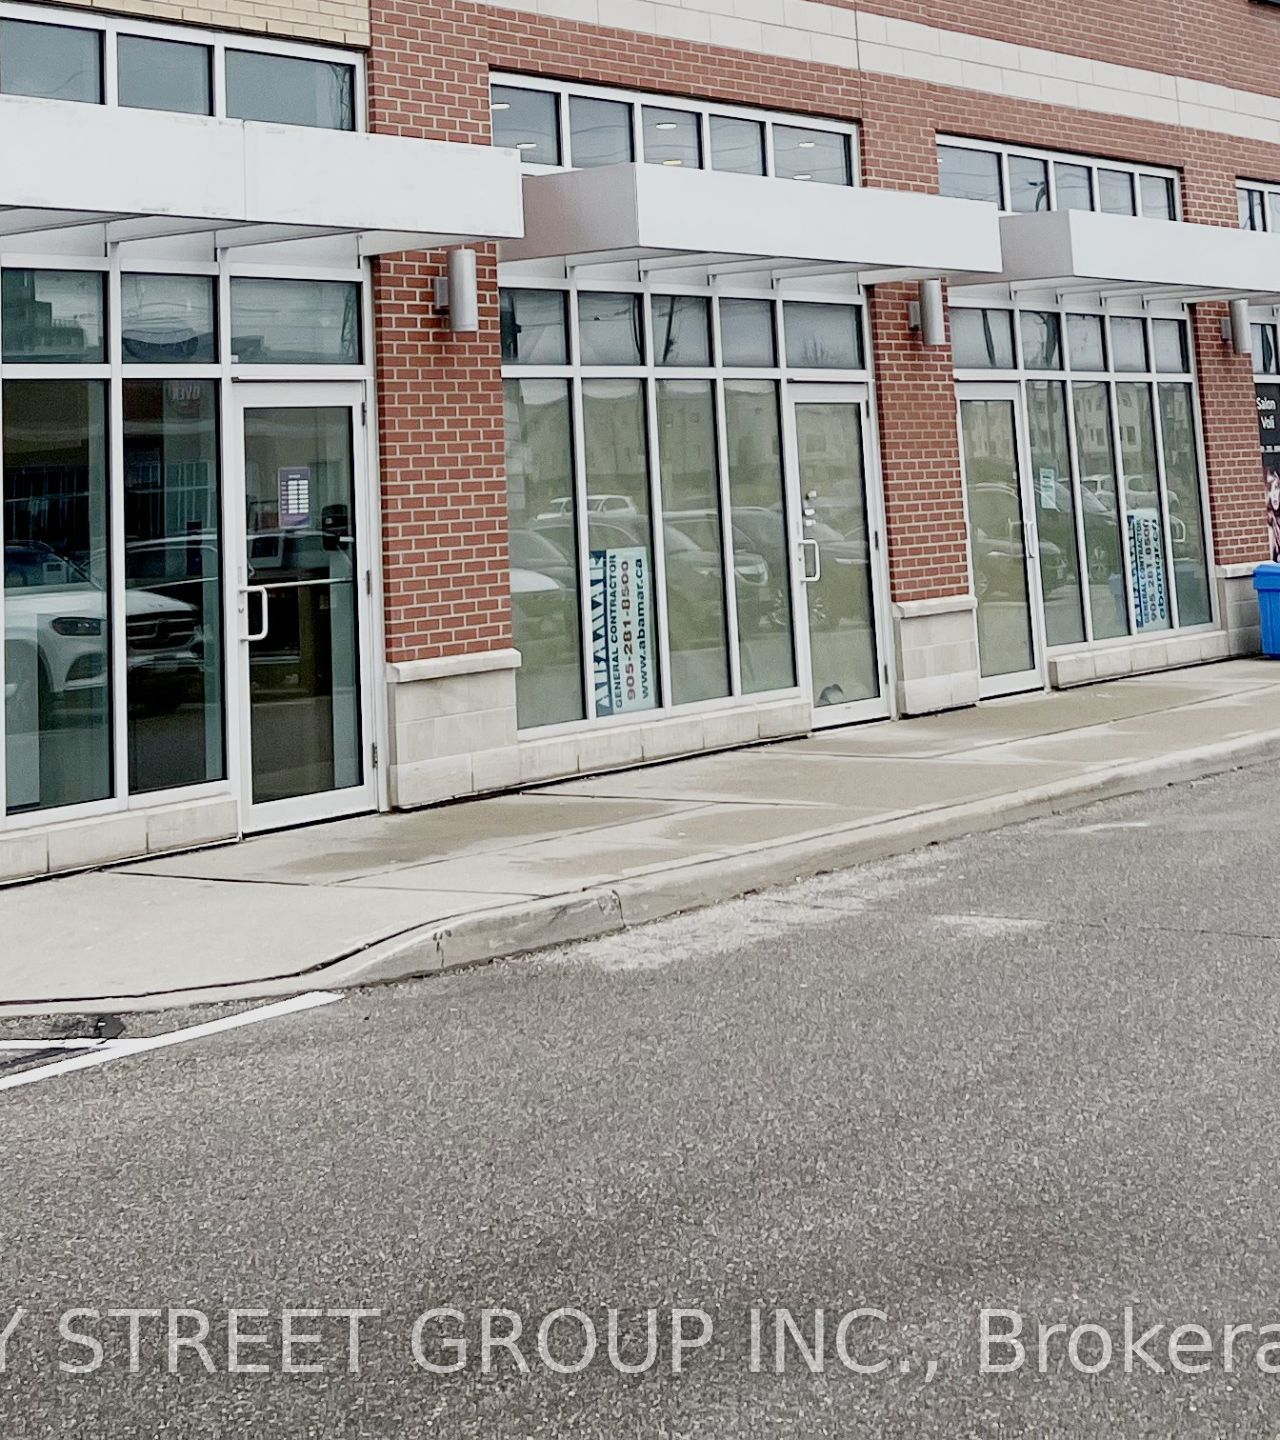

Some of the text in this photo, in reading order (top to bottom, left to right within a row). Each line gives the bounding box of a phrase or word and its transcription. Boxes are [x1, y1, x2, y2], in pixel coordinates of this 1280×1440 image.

[609, 554, 623, 709] GENERAL CONTRACTOR
[621, 560, 636, 701] 905-281-8500
[635, 558, 649, 699] www.abamar.ca
